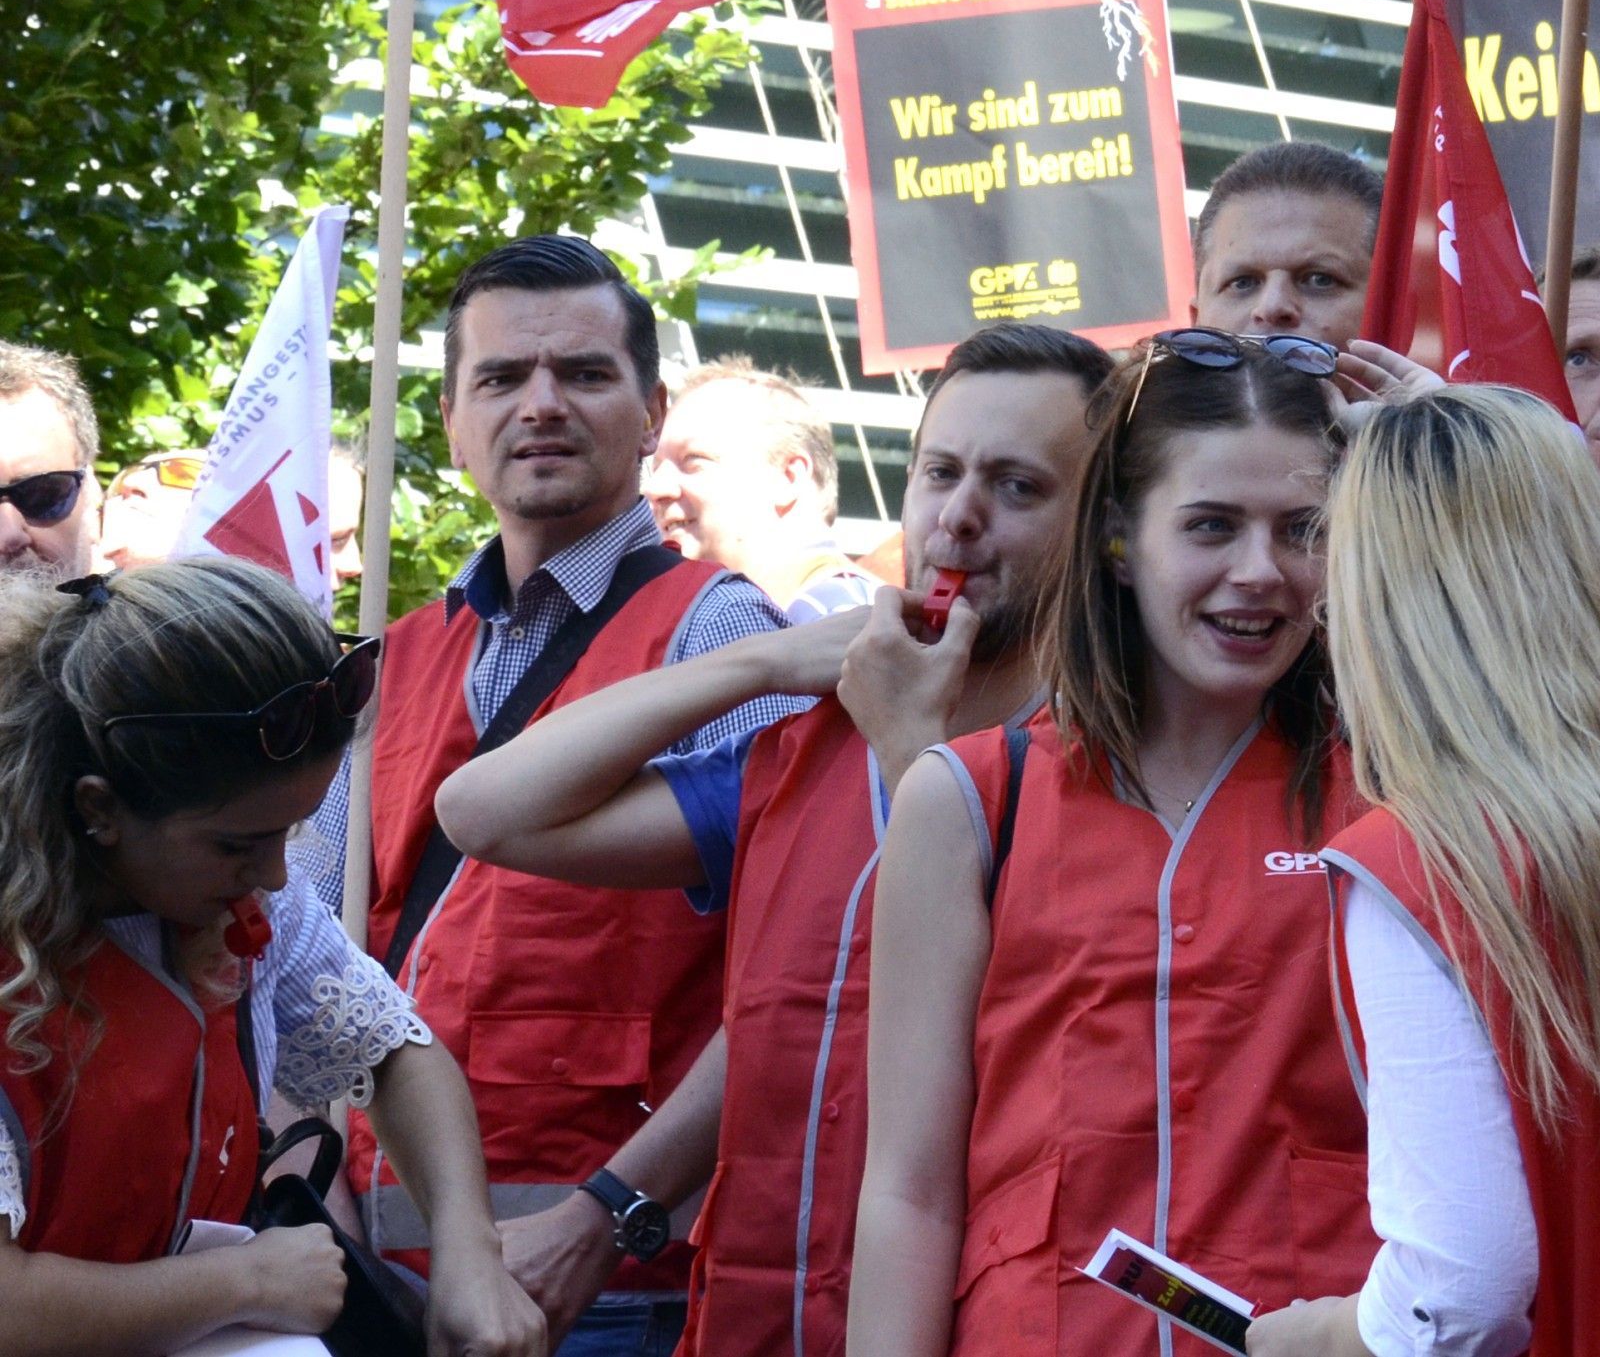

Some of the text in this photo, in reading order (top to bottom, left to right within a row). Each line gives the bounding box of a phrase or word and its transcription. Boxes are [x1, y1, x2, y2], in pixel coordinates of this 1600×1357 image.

[890, 81, 1122, 140] Wir sind zum
[895, 133, 1133, 203] Kampf bereit!
